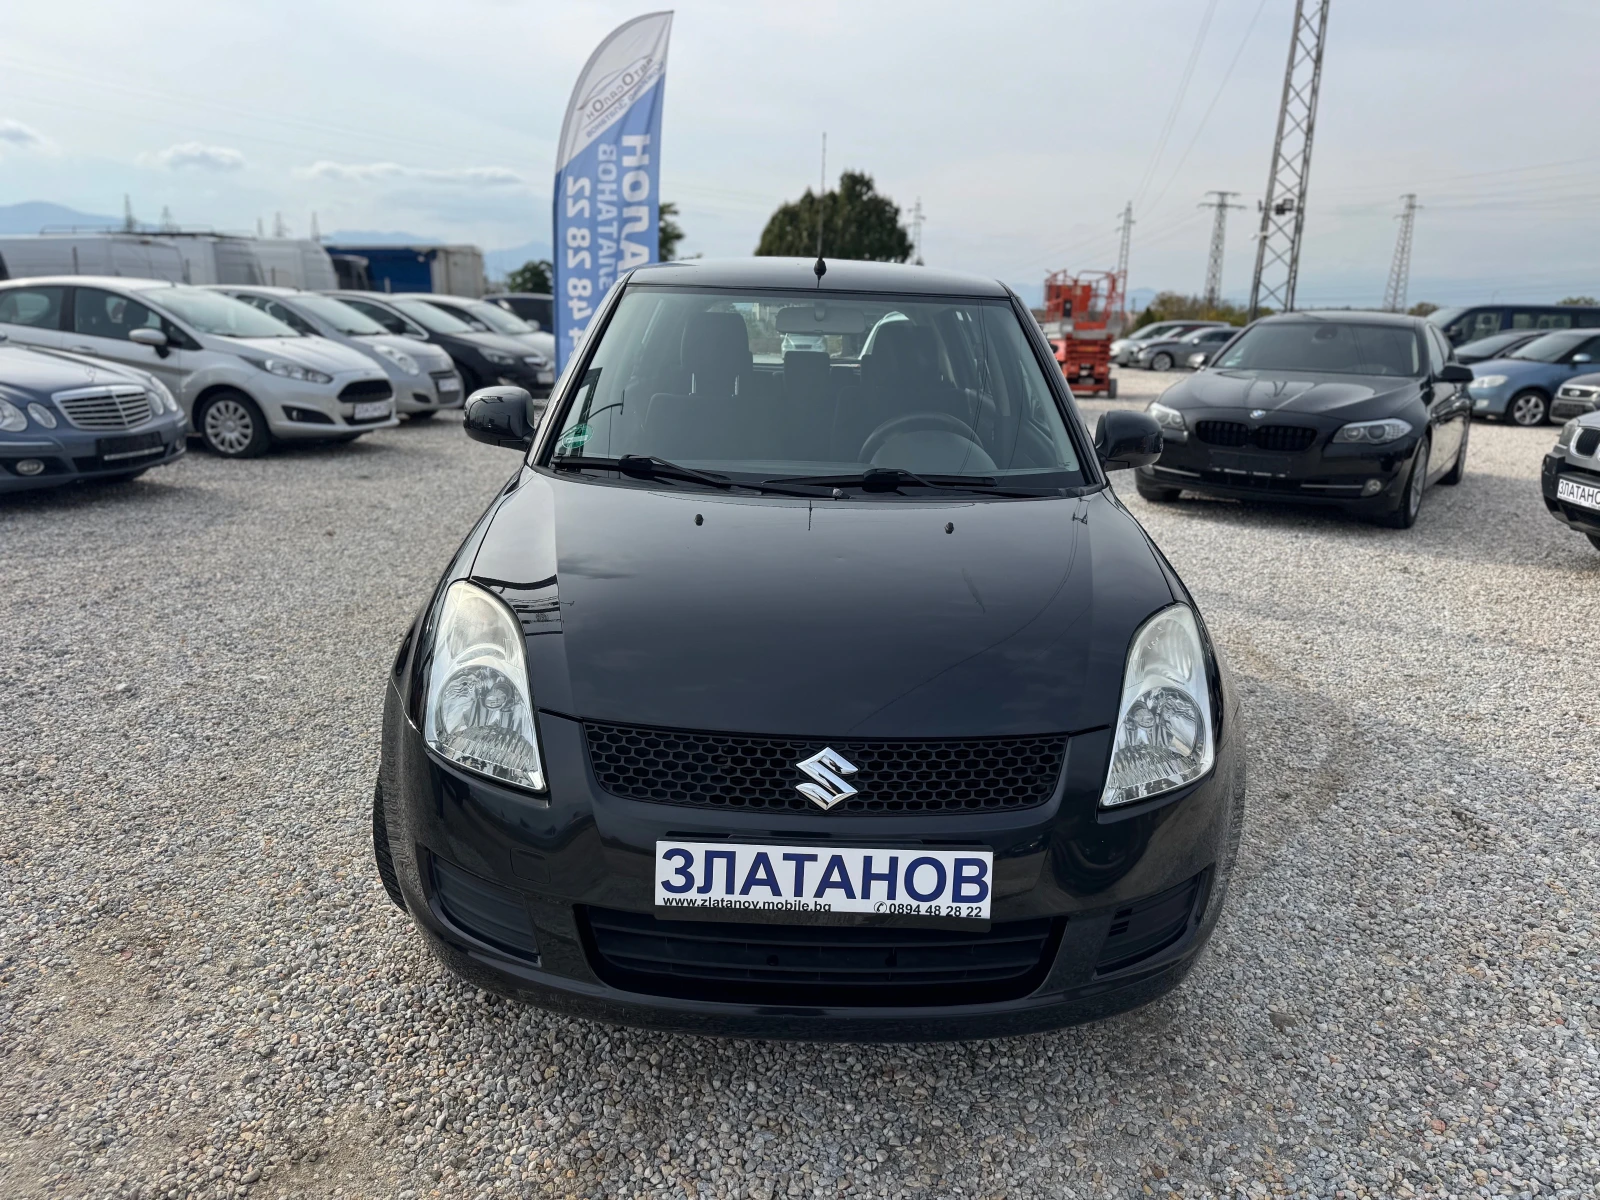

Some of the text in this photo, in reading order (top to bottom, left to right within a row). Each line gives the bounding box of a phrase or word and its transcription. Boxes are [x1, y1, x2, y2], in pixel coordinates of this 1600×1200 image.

[660, 847, 989, 904] ЗЛАТАНОВ
[662, 896, 832, 912] www.zlatanov.mobile.bg
[888, 903, 983, 918] 0894 48 28 22
